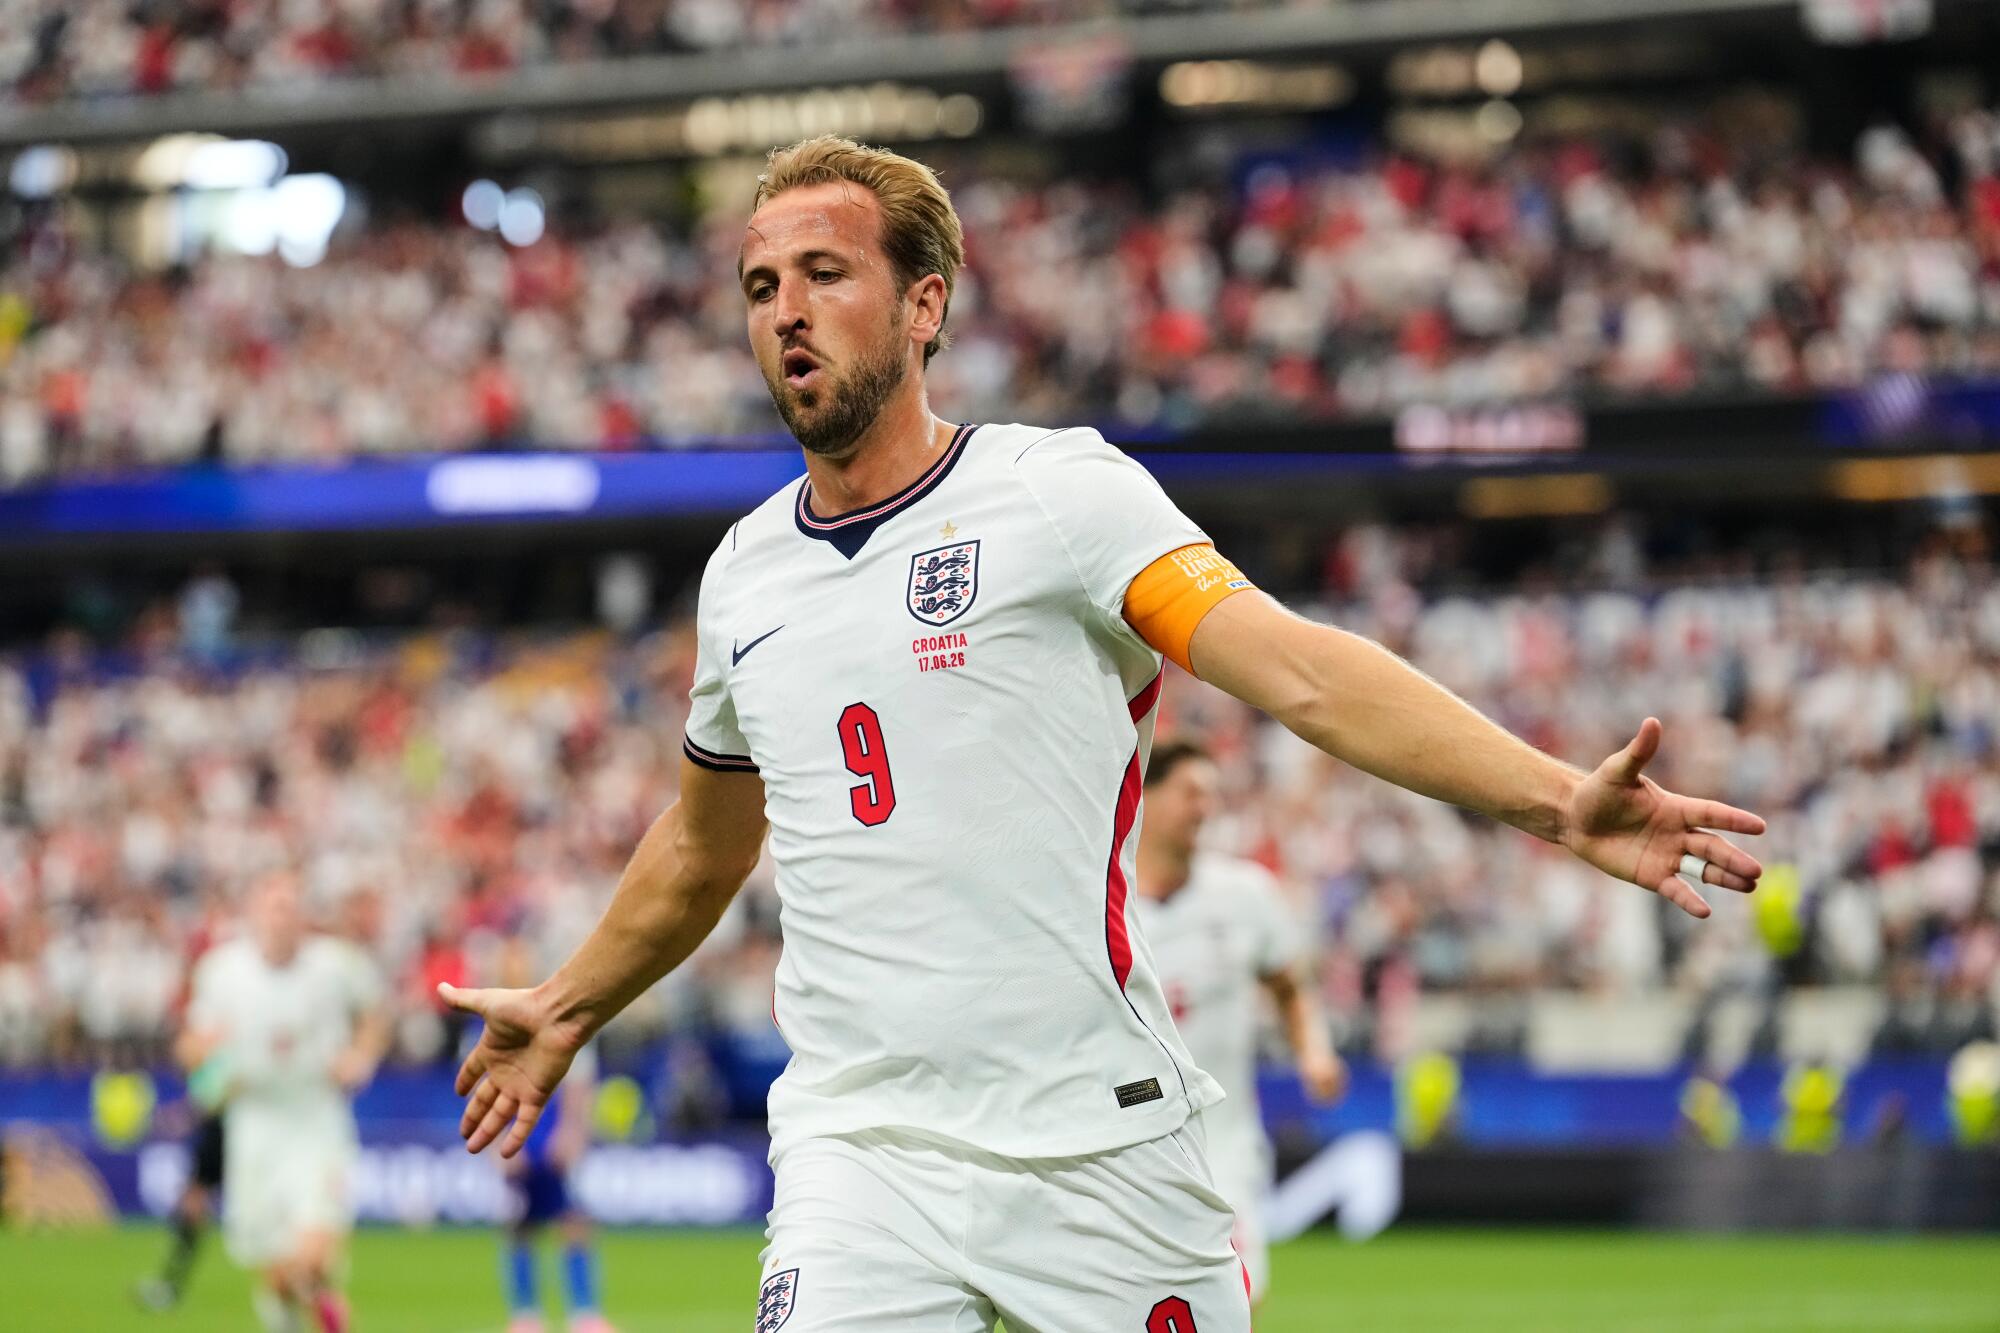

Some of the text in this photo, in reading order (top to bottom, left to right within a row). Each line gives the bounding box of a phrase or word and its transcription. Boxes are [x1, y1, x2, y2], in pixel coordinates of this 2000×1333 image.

[1196, 575, 1222, 592] the
[912, 632, 968, 654] CROATIA
[918, 652, 965, 672] 17.06.26
[837, 701, 896, 827] 9
